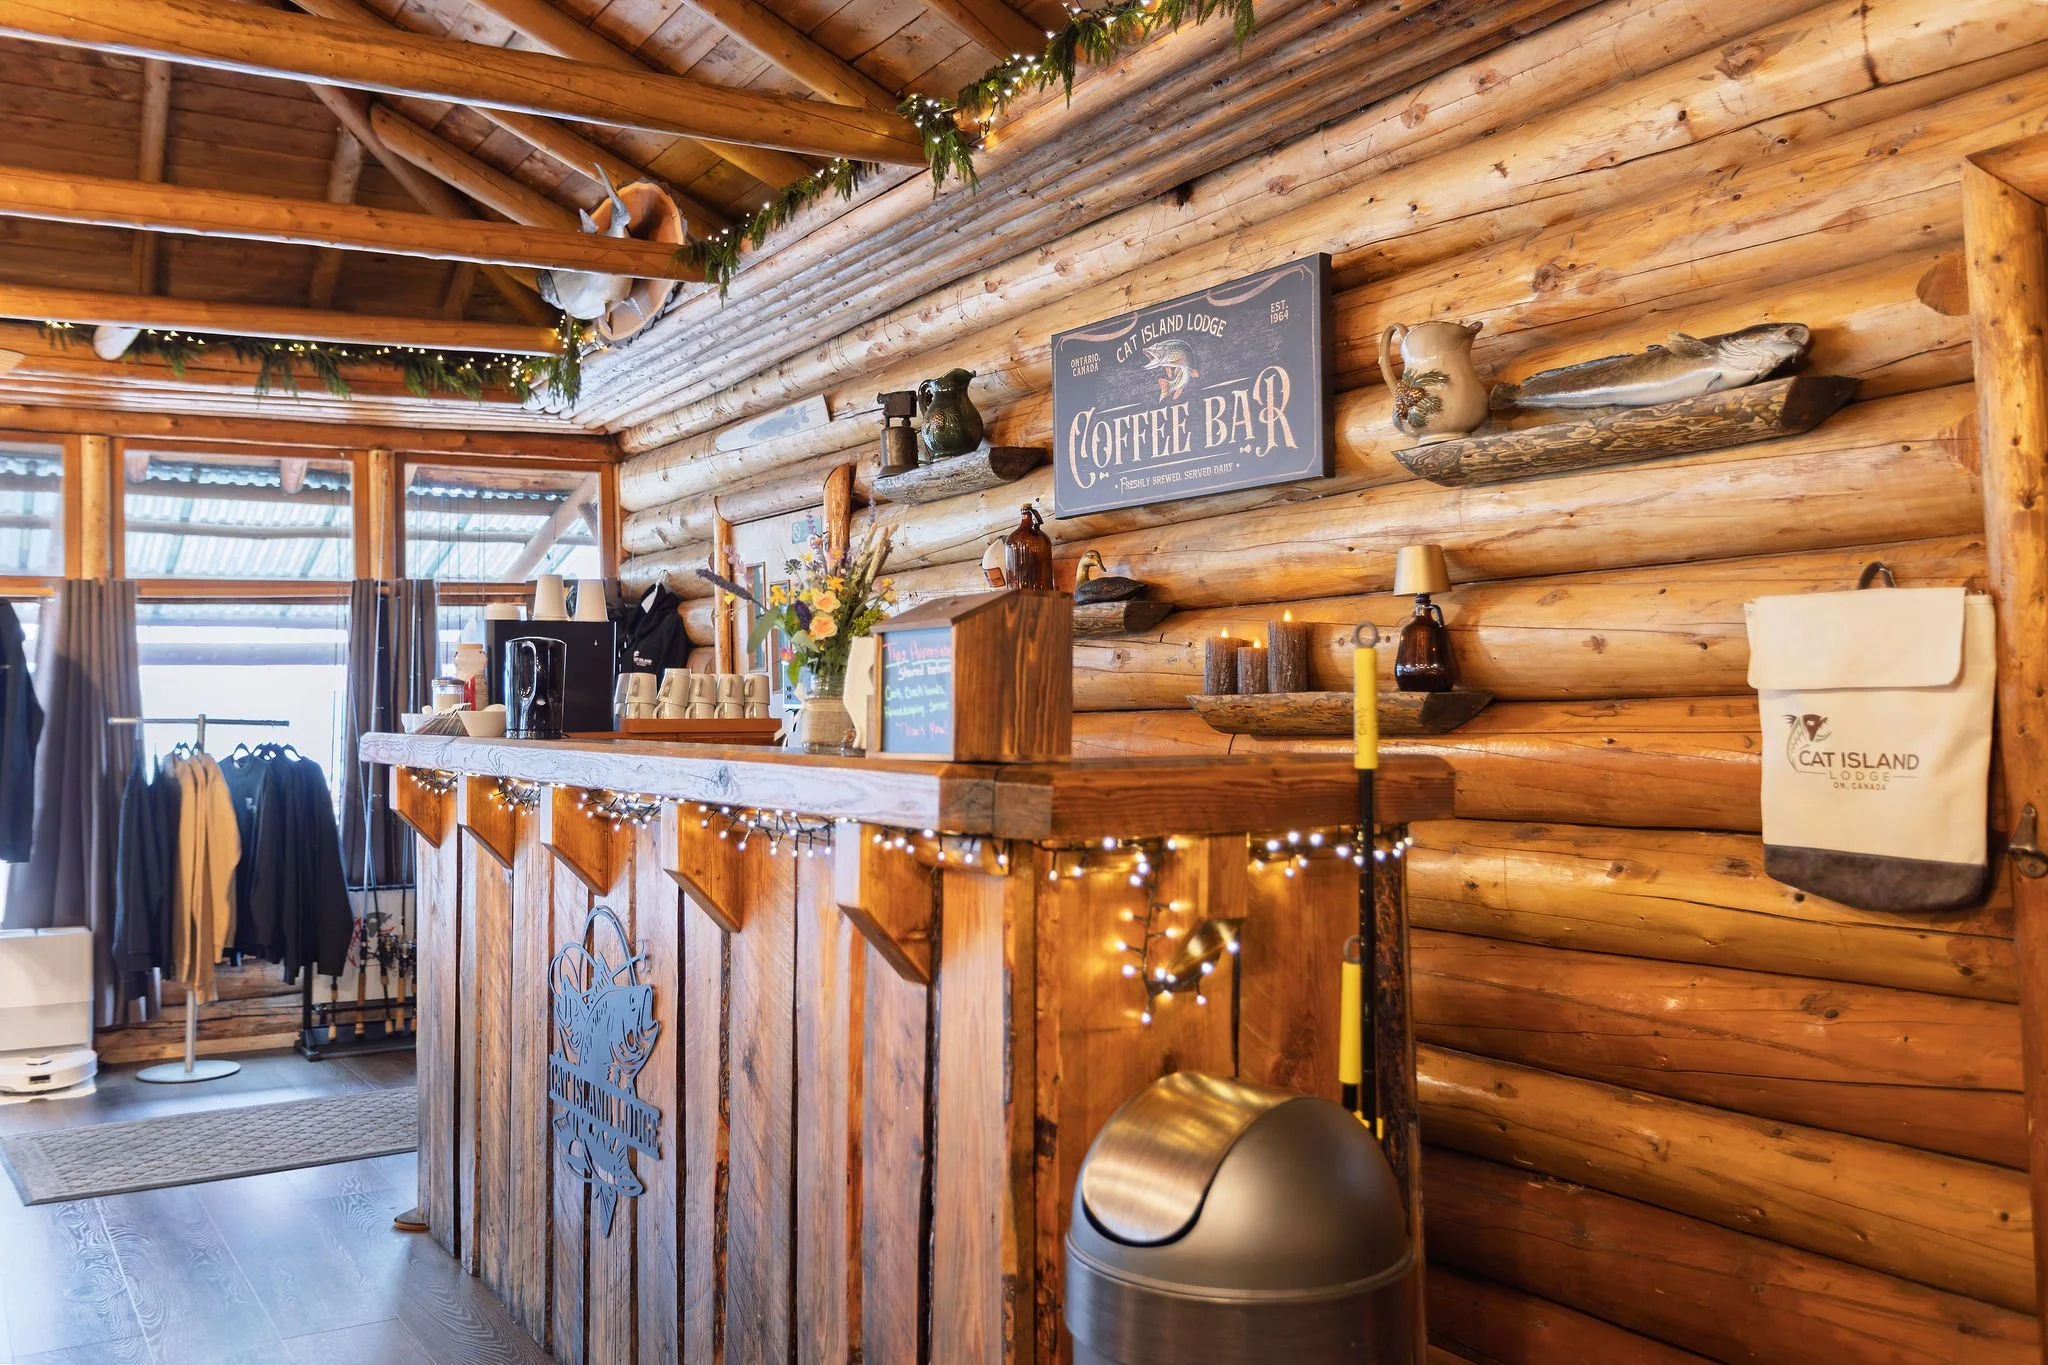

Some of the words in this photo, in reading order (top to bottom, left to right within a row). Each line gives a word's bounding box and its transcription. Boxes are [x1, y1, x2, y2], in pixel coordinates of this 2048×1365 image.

[1270, 300, 1288, 312] EST.
[1270, 309, 1288, 324] 1964
[1116, 334, 1137, 363] CAT
[1141, 314, 1183, 344] ISLAND
[1187, 313, 1227, 338] LODGE
[1072, 363, 1099, 377] CANADA
[1069, 402, 1192, 489] COFFEE
[1203, 366, 1299, 457] BAR
[1120, 477, 1150, 495] FRESHLY
[1184, 466, 1212, 480] SERVED
[1214, 462, 1233, 475] DAILY
[1799, 750, 1835, 767] CAT
[1841, 752, 1920, 770] ISLAND
[1829, 770, 1890, 782] LODGE
[1851, 782, 1886, 791] CANADA
[551, 1063, 571, 1101] CAT
[573, 1075, 614, 1127] ISLAND
[617, 1098, 657, 1148] LODGE
